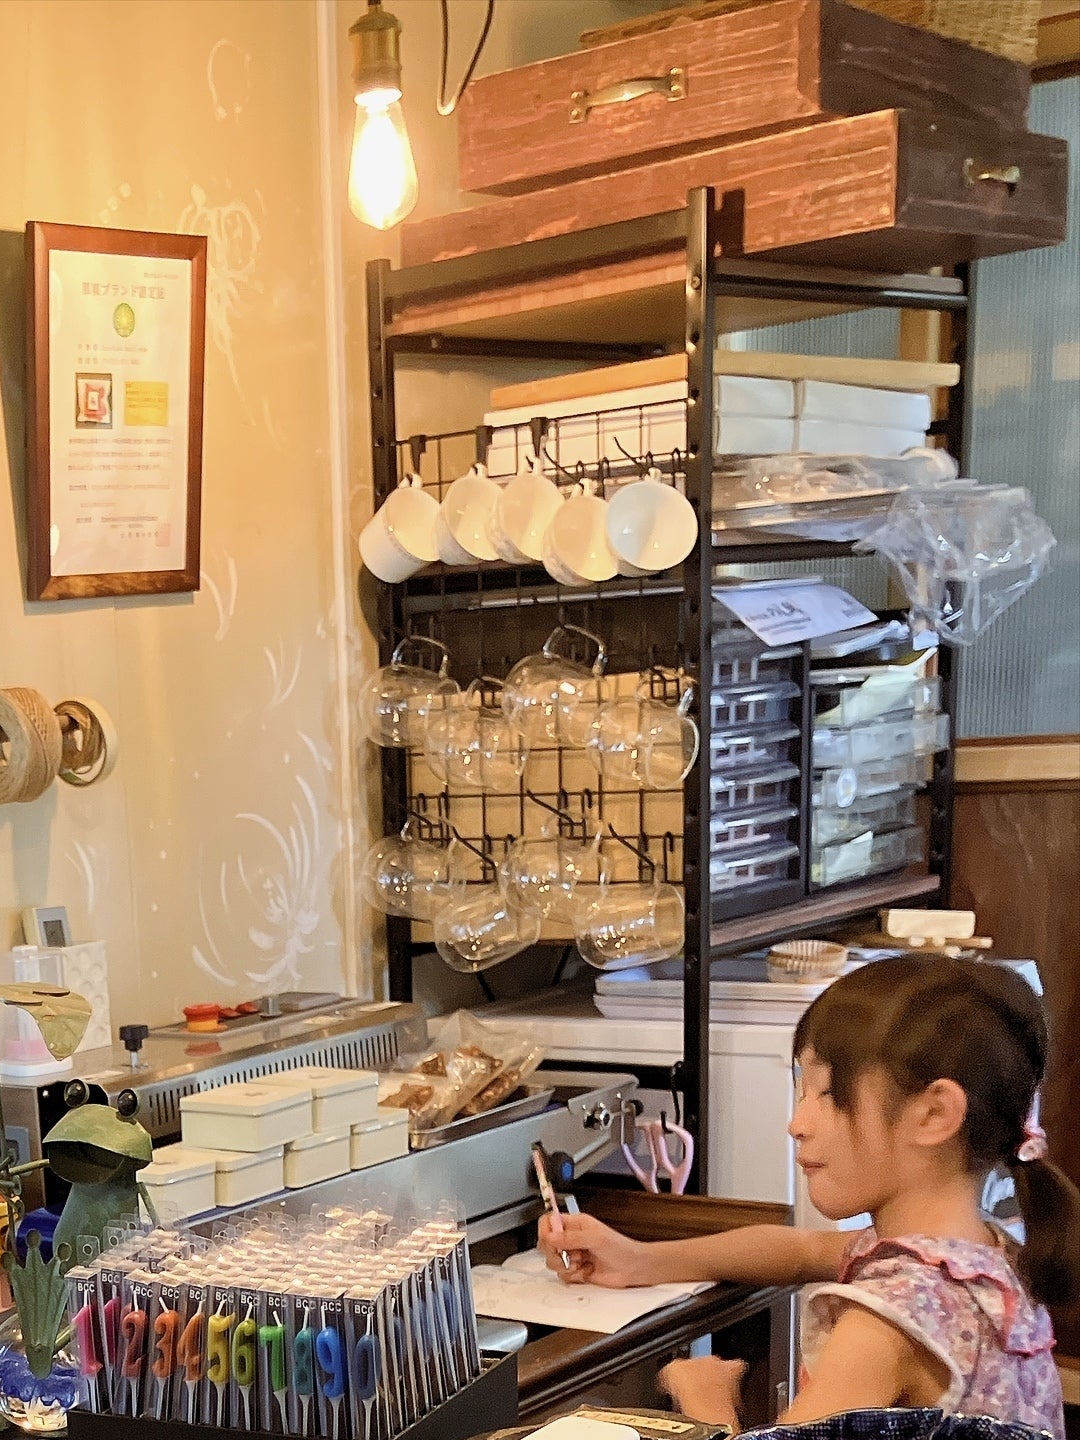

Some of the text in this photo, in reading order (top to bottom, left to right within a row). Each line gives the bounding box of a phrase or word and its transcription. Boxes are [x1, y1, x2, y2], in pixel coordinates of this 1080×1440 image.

[78, 1283, 95, 1292] BCC
[135, 1286, 153, 1297] BCC
[162, 1287, 180, 1298] BCC
[322, 1302, 341, 1311] BCC
